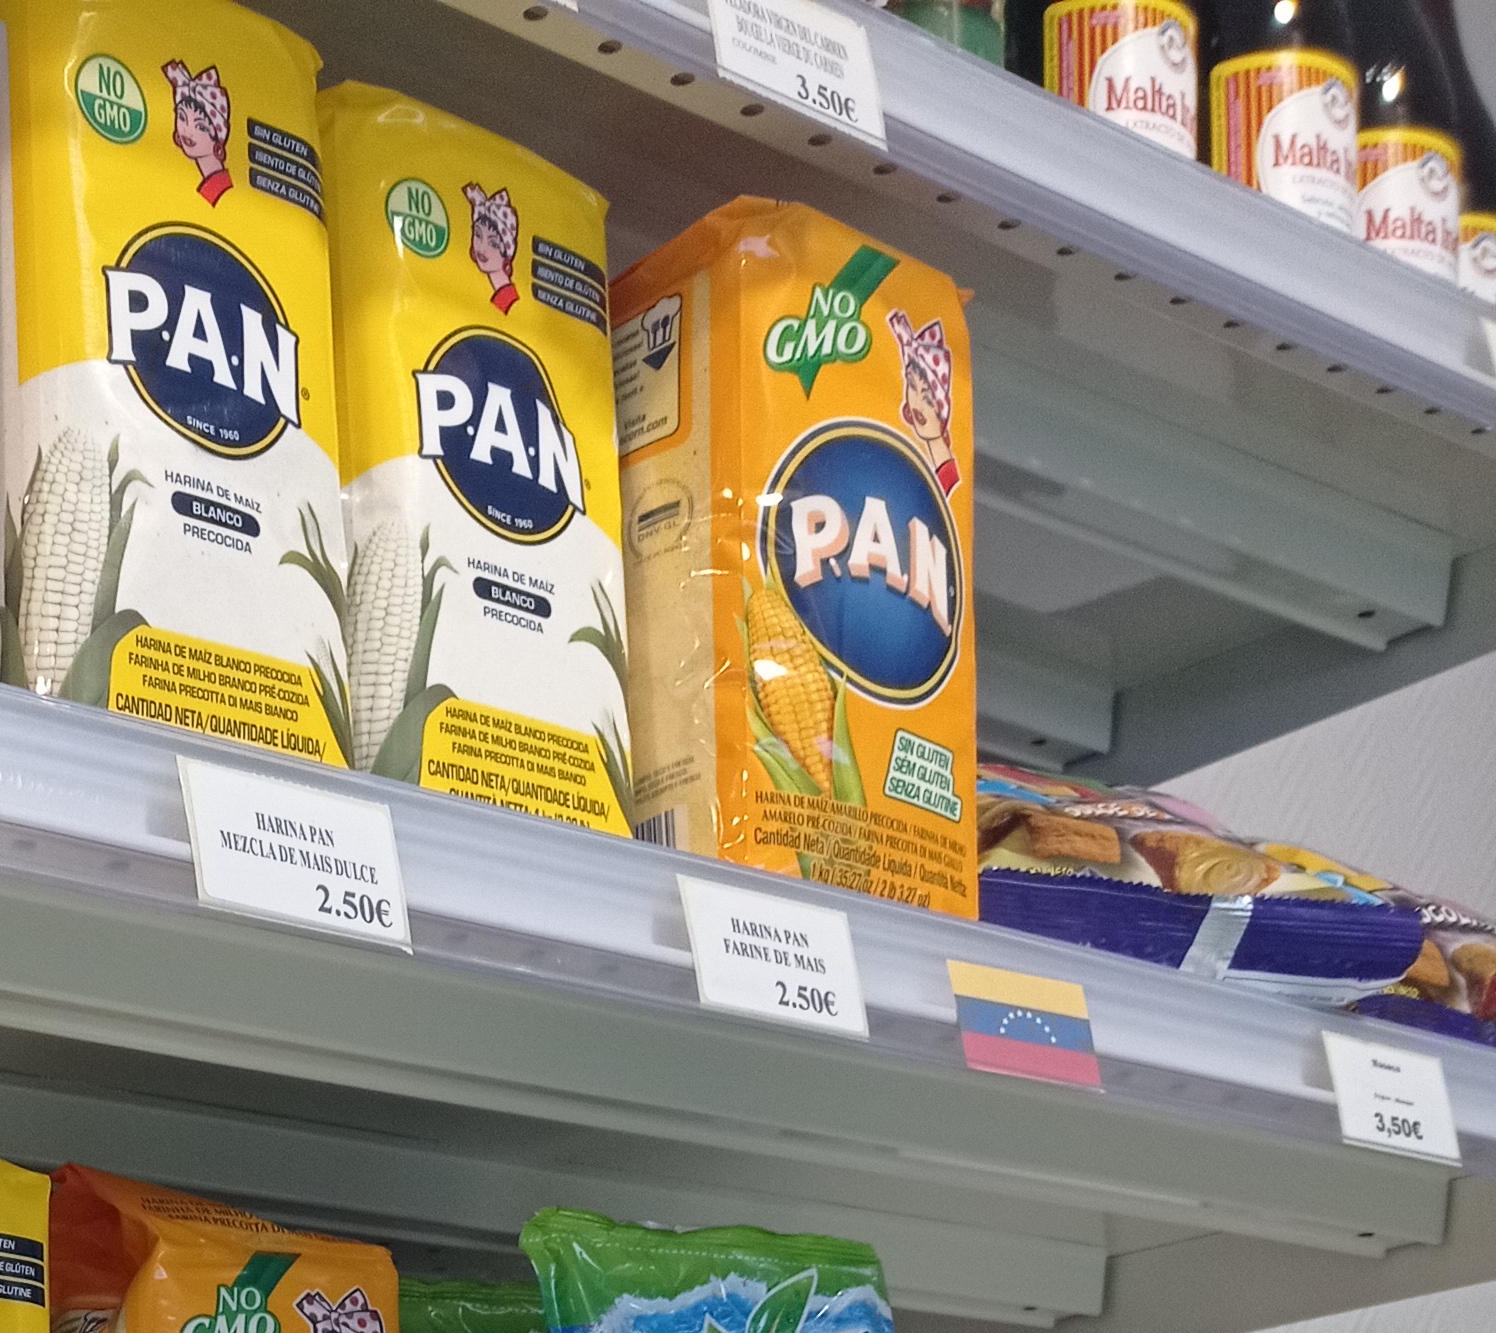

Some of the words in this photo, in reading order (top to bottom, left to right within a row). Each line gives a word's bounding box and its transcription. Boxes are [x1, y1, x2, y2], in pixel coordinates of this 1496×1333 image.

[97, 63, 125, 98] NO
[795, 74, 859, 123] 3.50€
[93, 101, 130, 135] GMO
[810, 285, 855, 318] NO
[765, 319, 867, 365] GMO
[255, 811, 307, 841] HARINA
[308, 825, 335, 848] PAN
[220, 830, 277, 861] MEZCLA
[279, 846, 298, 865] DE
[300, 851, 332, 874] MAIS
[335, 858, 378, 885] DULCE
[315, 884, 393, 928] 2.50€
[775, 980, 838, 1017] 2.50€
[1374, 1111, 1424, 1142] 3,50€
[218, 1285, 261, 1312] NO
